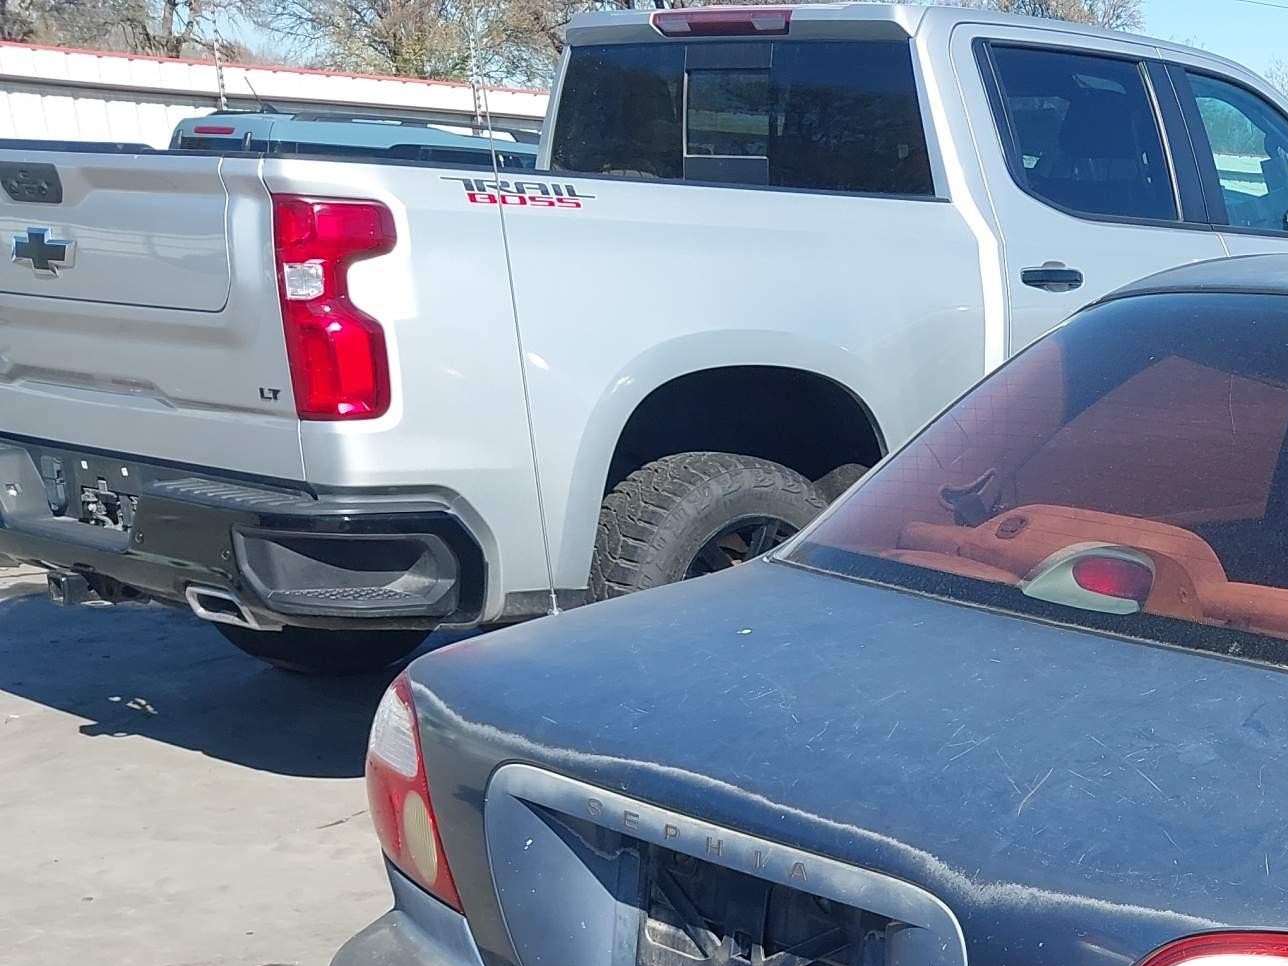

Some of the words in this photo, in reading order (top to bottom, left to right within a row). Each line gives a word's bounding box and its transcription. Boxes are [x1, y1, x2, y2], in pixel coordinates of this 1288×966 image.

[440, 176, 596, 199] TRAIL
[467, 192, 582, 209] BOSS
[259, 387, 281, 401] LT
[586, 797, 808, 882] SEPHIA
